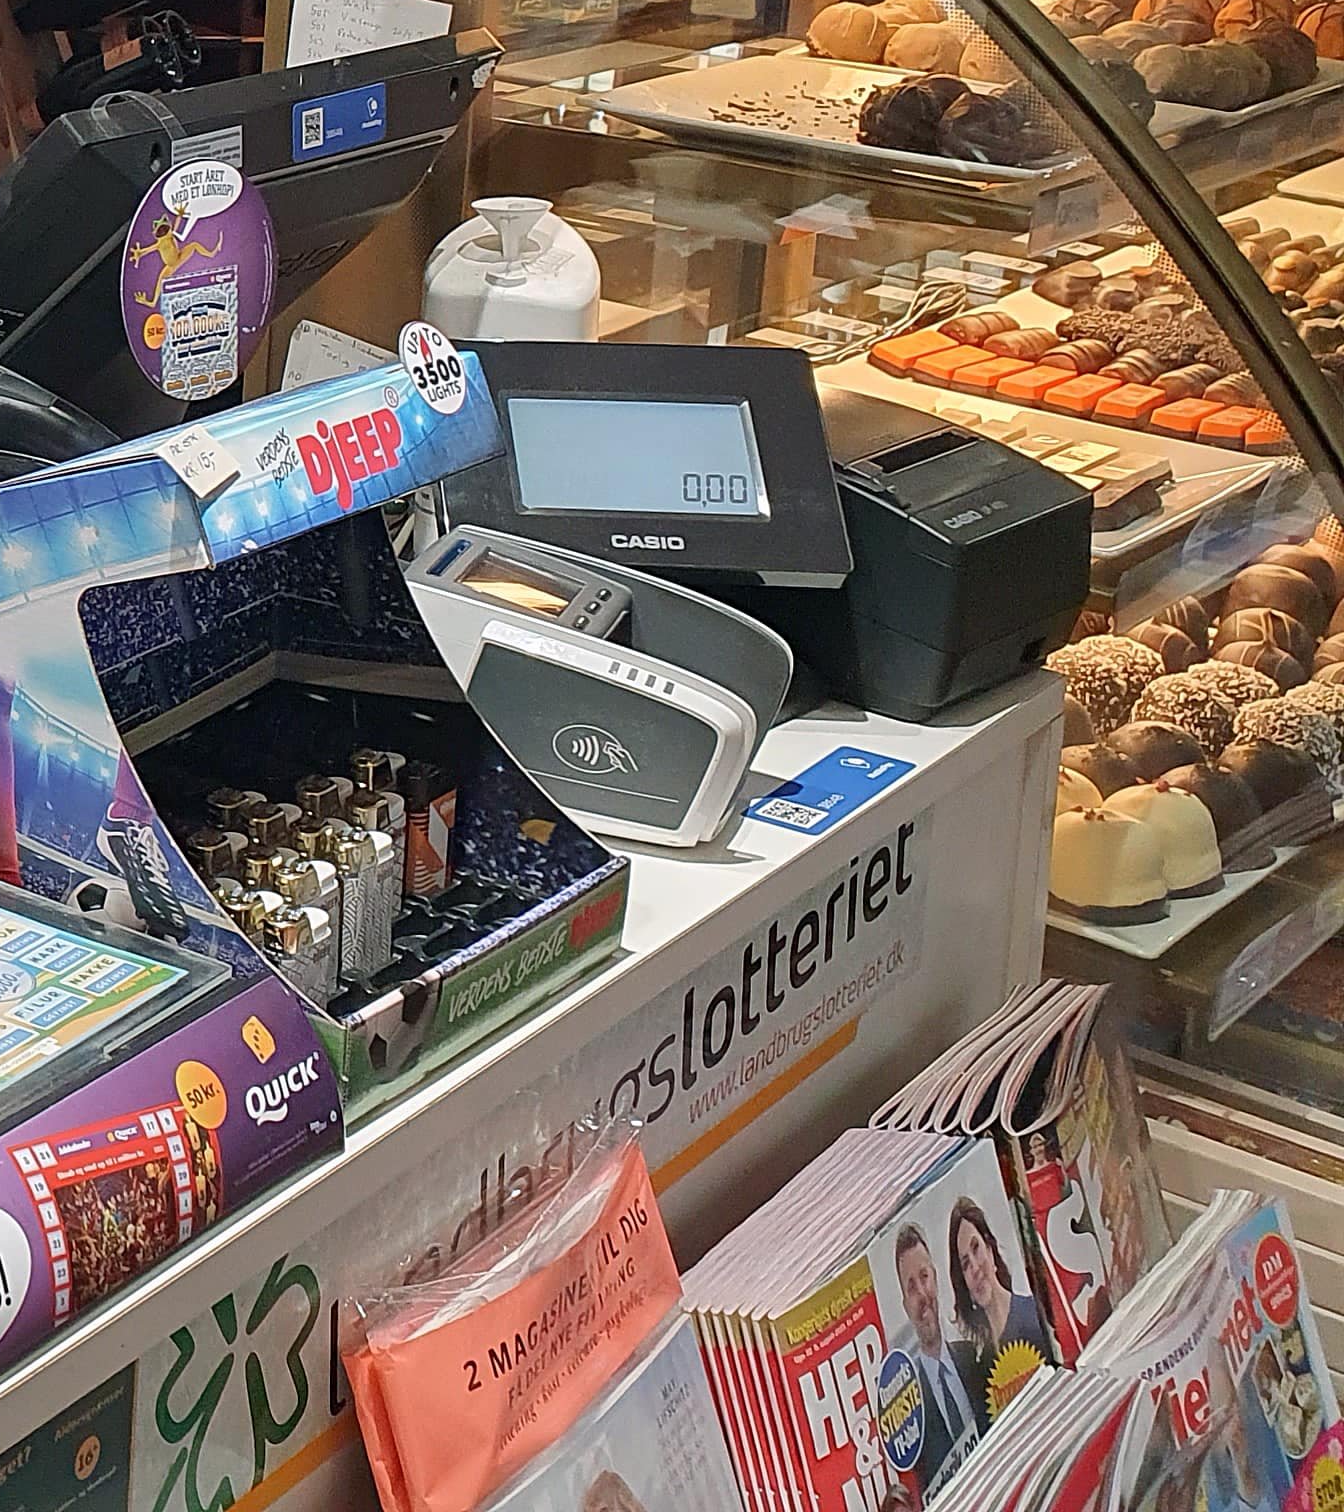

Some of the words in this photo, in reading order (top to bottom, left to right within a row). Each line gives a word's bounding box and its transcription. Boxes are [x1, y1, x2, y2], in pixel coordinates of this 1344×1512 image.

[407, 332, 424, 356] UP
[425, 326, 442, 346] TO
[412, 354, 462, 389] 3500
[426, 380, 462, 404] LIGHTS
[611, 532, 685, 552] CASIO
[28, 943, 63, 964] MARK
[69, 957, 114, 986] NAKKE
[15, 990, 60, 1019] FILUR
[688, 934, 906, 1126] www.landbrugslotteriet.dk
[186, 1086, 209, 1108] 50
[208, 1081, 221, 1102] kr.
[246, 1052, 316, 1126] QUICK
[464, 1360, 482, 1391] 2
[619, 1198, 648, 1241] DIG
